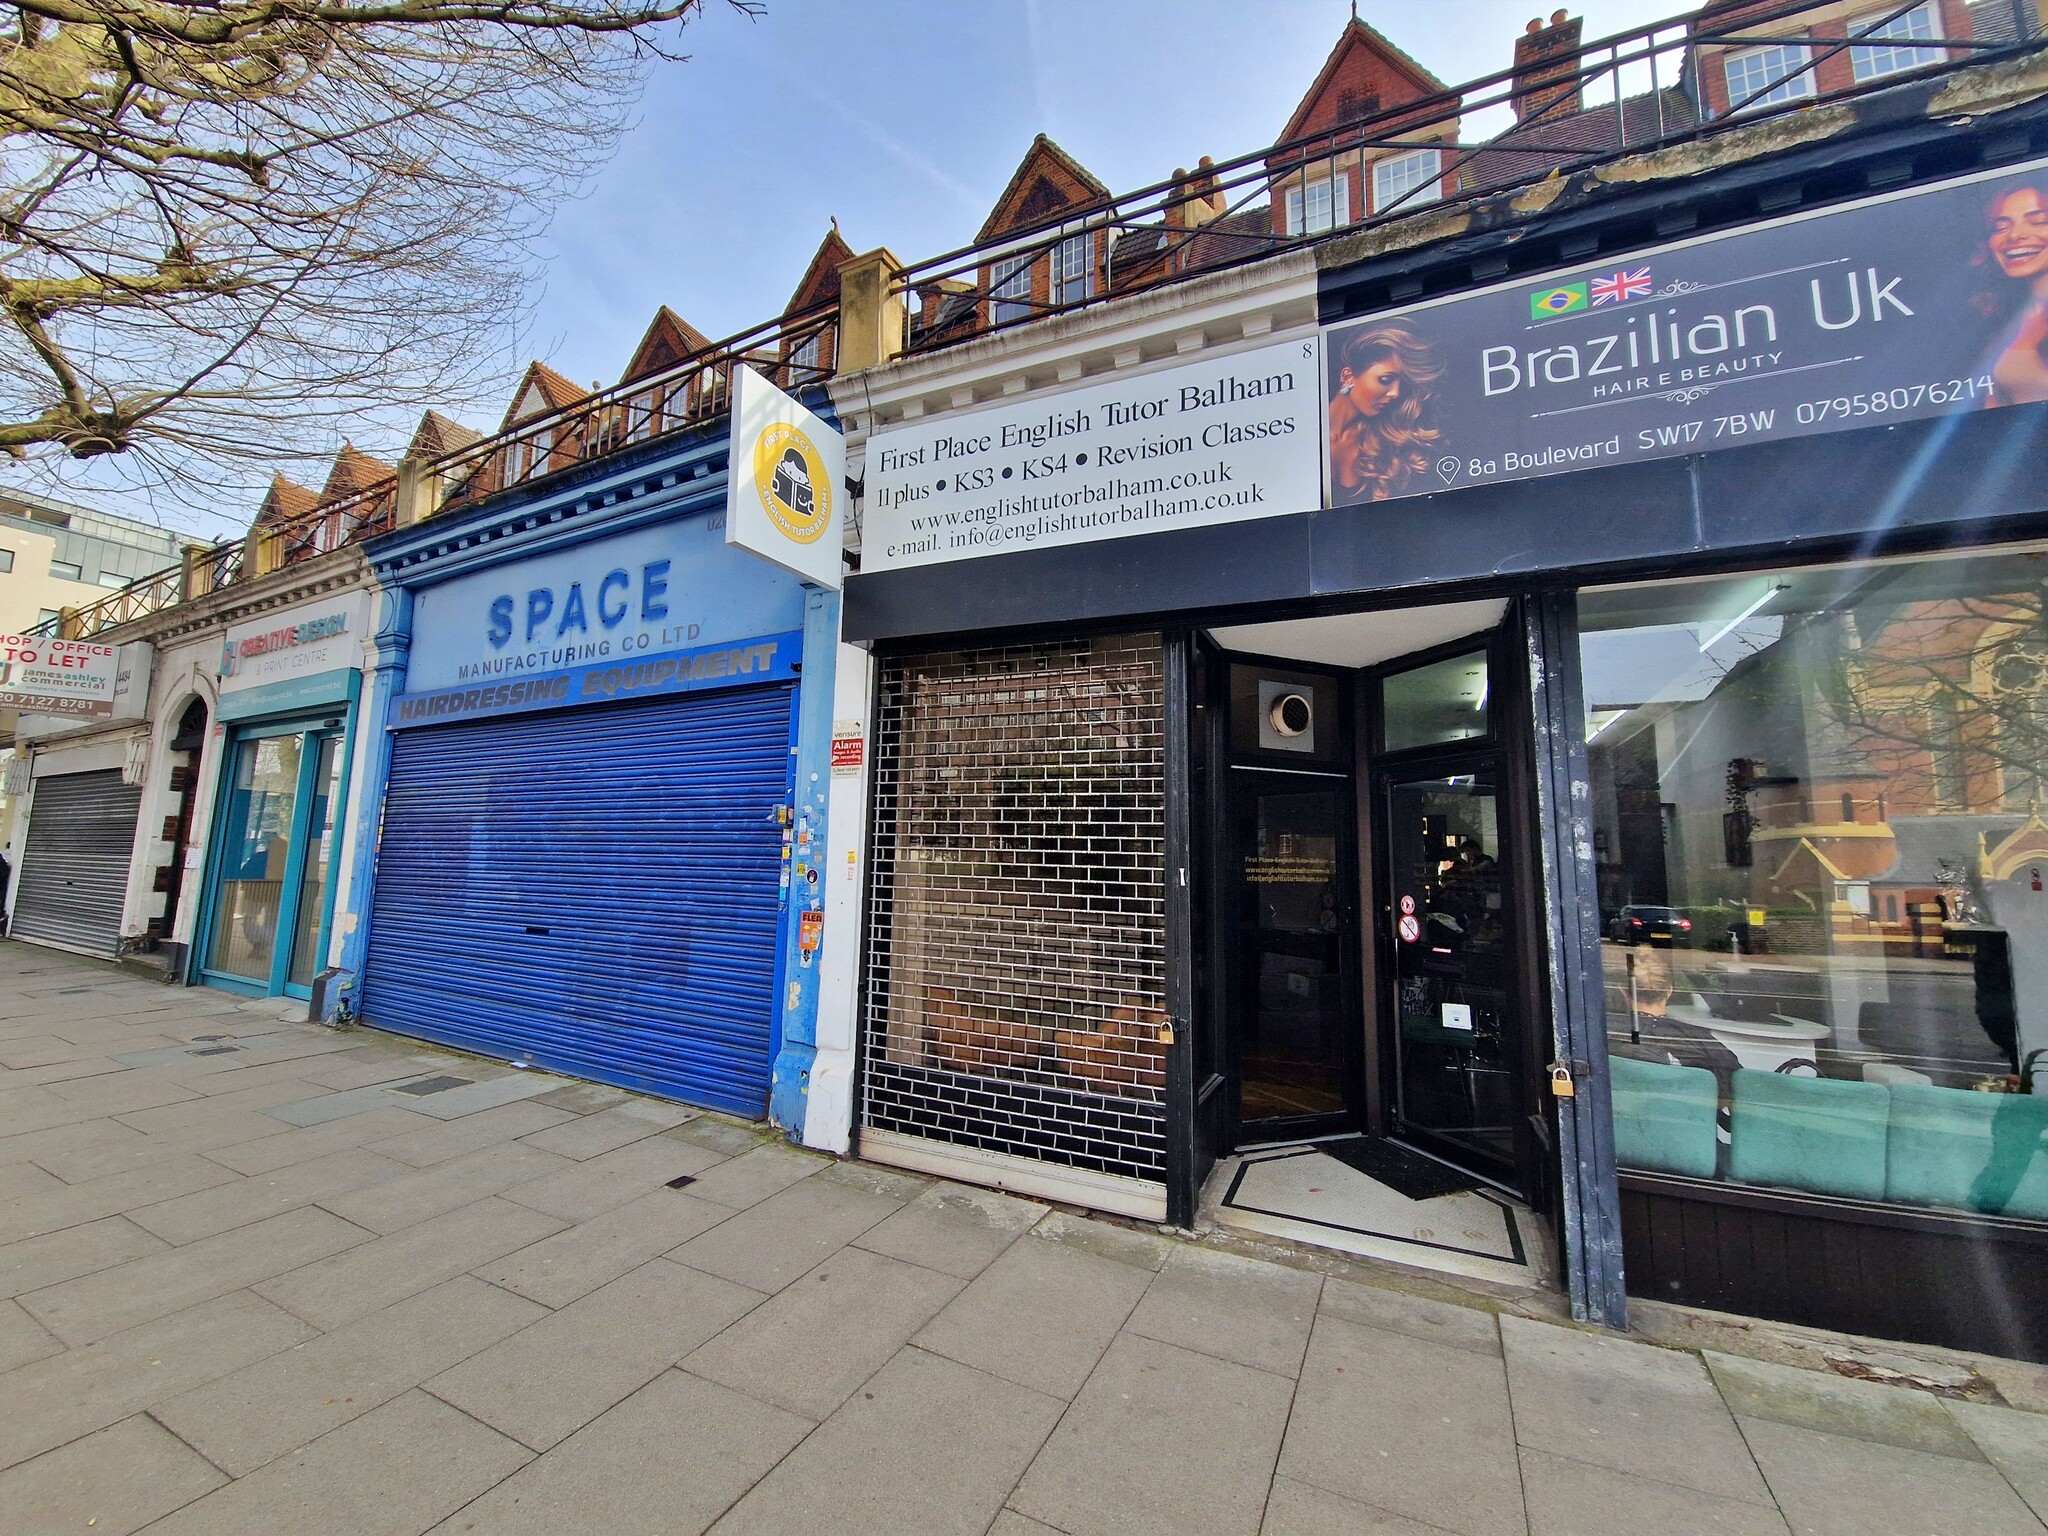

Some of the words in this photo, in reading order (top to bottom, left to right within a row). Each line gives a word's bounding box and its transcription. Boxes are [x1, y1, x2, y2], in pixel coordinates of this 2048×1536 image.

[1302, 343, 1313, 359] 8
[1482, 304, 1777, 397] Brazilian
[1810, 267, 1915, 330] Uk
[1593, 376, 1649, 398] HAIR
[1659, 372, 1672, 386] E
[1681, 351, 1783, 382] BEAUTY
[764, 430, 783, 449] FIRST
[784, 431, 811, 453] PLACE
[879, 446, 926, 473] First
[933, 435, 992, 461] Place
[999, 407, 1092, 448] English
[1101, 398, 1169, 428] Tutor
[1178, 372, 1295, 413] Balham
[1468, 458, 1497, 477] 8a
[1504, 435, 1620, 471] Boulevard
[1638, 420, 1704, 450] SW17
[1713, 409, 1775, 438] 7BW
[1796, 374, 1995, 424] 07958076214
[894, 484, 930, 509] plus
[954, 467, 994, 493] KS3
[1021, 453, 1068, 481] KS4
[1096, 434, 1194, 467] Revision
[1202, 417, 1295, 448] Classes
[763, 491, 791, 530] ENGLISH
[791, 525, 815, 537] TUTOR
[814, 493, 829, 529] BALHAM
[911, 461, 1233, 531] www.englishtutorbalham.co.uk
[887, 533, 941, 557] e-mail.
[950, 483, 1265, 547] info@englishtutorbalham.co.uk
[488, 559, 672, 649] SPACE
[5, 648, 38, 663] TO
[48, 653, 90, 669] LET
[52, 641, 113, 656] OFFICE
[264, 658, 288, 674] PRINT
[292, 648, 328, 668] CENTRE
[458, 640, 610, 679] MANUFACTURING
[622, 633, 650, 652] CO
[662, 623, 700, 645] LTD
[21, 676, 105, 690] commercial
[23, 668, 62, 679] james
[64, 672, 106, 684] ashley
[399, 675, 571, 721] HAIRDRESSING
[582, 642, 778, 696] EQUIPMENT
[19, 694, 56, 706] 7127
[59, 698, 94, 709] 8781
[834, 741, 862, 750] Alarm
[802, 914, 822, 922] FLEA
